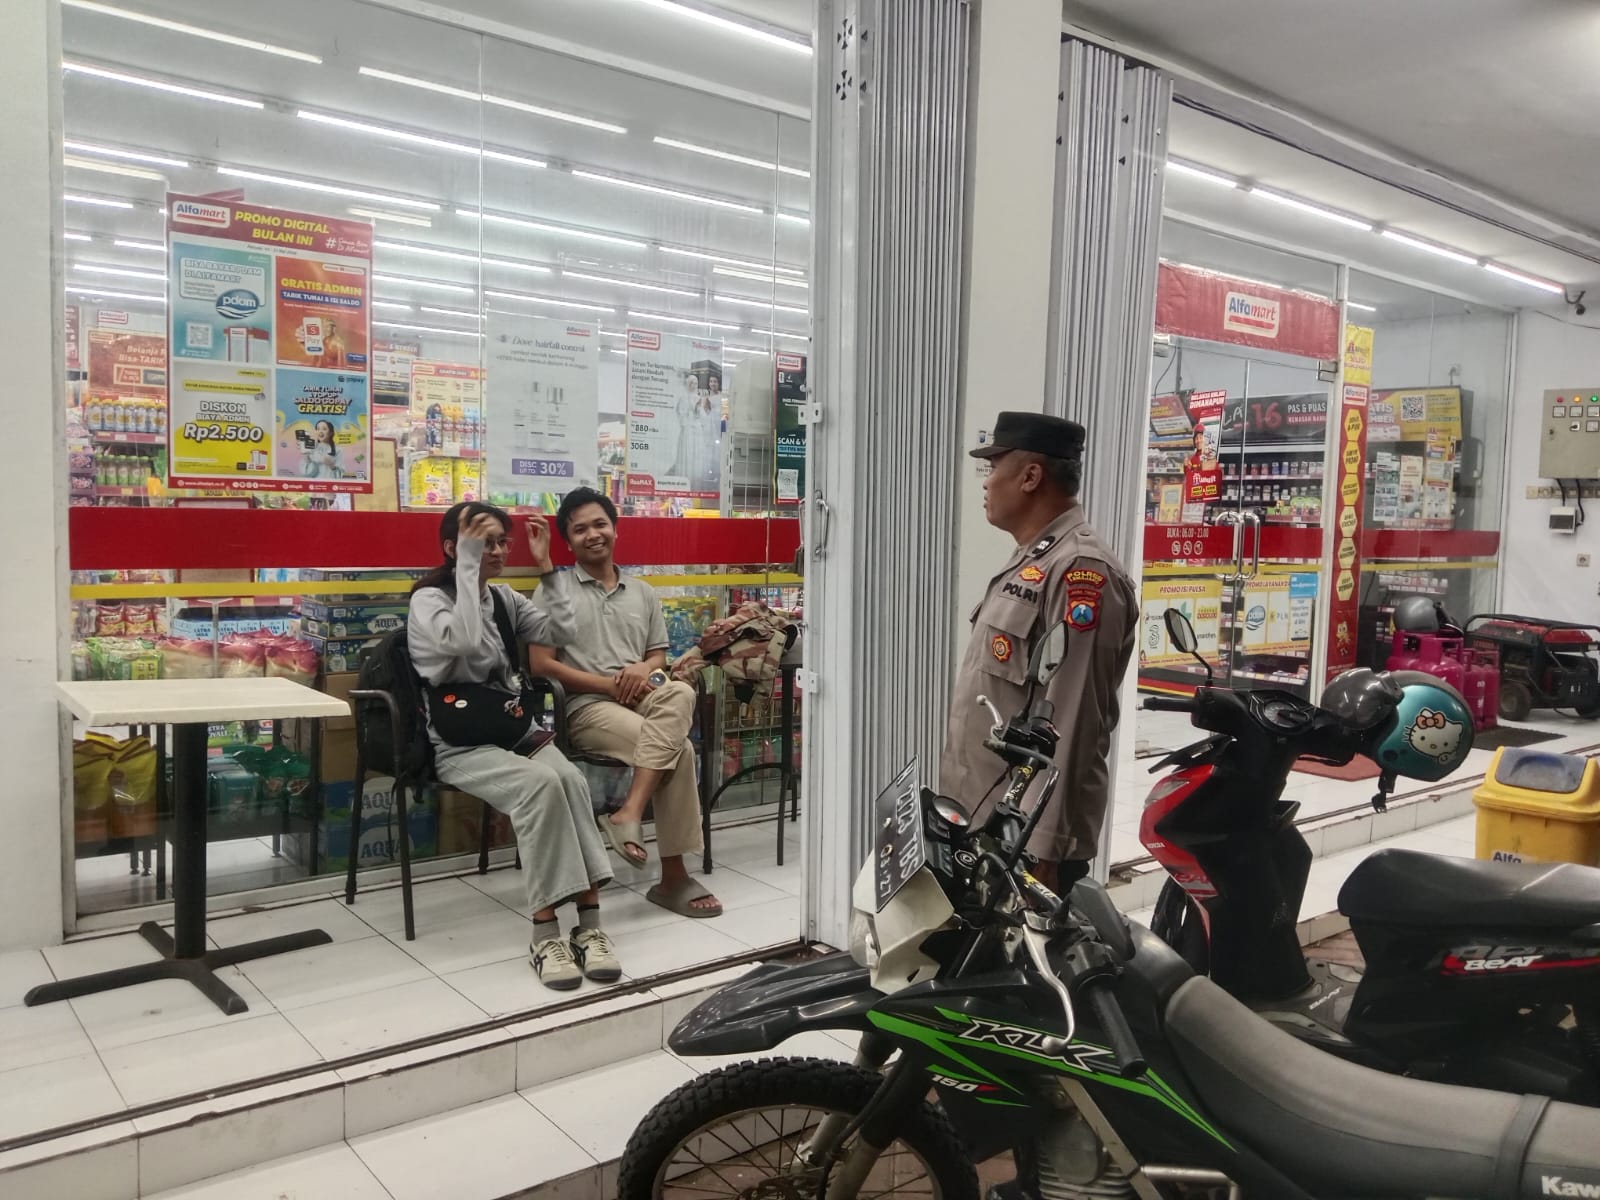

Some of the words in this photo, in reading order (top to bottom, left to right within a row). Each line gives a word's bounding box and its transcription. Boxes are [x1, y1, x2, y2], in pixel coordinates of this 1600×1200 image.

[176, 203, 227, 219] Alfamart
[234, 210, 281, 228] PROMO
[283, 217, 330, 235] DIGITAL
[252, 227, 295, 244] BULAN
[296, 233, 314, 246] INI
[280, 278, 322, 291] GRATIS
[323, 284, 362, 297] ADMIN
[222, 294, 257, 310] pdam
[282, 291, 302, 300] TARIK
[303, 293, 324, 302] TUNAI
[339, 298, 361, 306] SALDO
[1228, 297, 1277, 321] Alfamart
[535, 339, 560, 350] hairfall
[561, 344, 585, 353] control
[200, 400, 247, 414] DISKON
[298, 404, 348, 415] GRATIS!
[1287, 403, 1301, 413] PAS
[1301, 403, 1307, 413] &
[1308, 402, 1327, 412] PUAS
[221, 415, 250, 423] ADMIN
[1250, 401, 1282, 430] 16
[184, 423, 263, 442] Rp2.500
[630, 442, 649, 450] 30GB
[777, 437, 795, 445] SCAN
[519, 461, 537, 469] DISC
[540, 462, 567, 476] 30%
[1166, 527, 1180, 538] BUKA
[1066, 571, 1104, 582] POLRES
[1002, 582, 1038, 603] POLRI
[1160, 585, 1181, 594] PROMO
[1188, 585, 1206, 593] PULSA
[373, 617, 398, 629] AQUA
[361, 791, 399, 810] AQU
[895, 783, 916, 834] 2723
[1145, 841, 1166, 849] HONDA
[897, 830, 920, 880] TBS
[931, 1073, 979, 1093] 150
